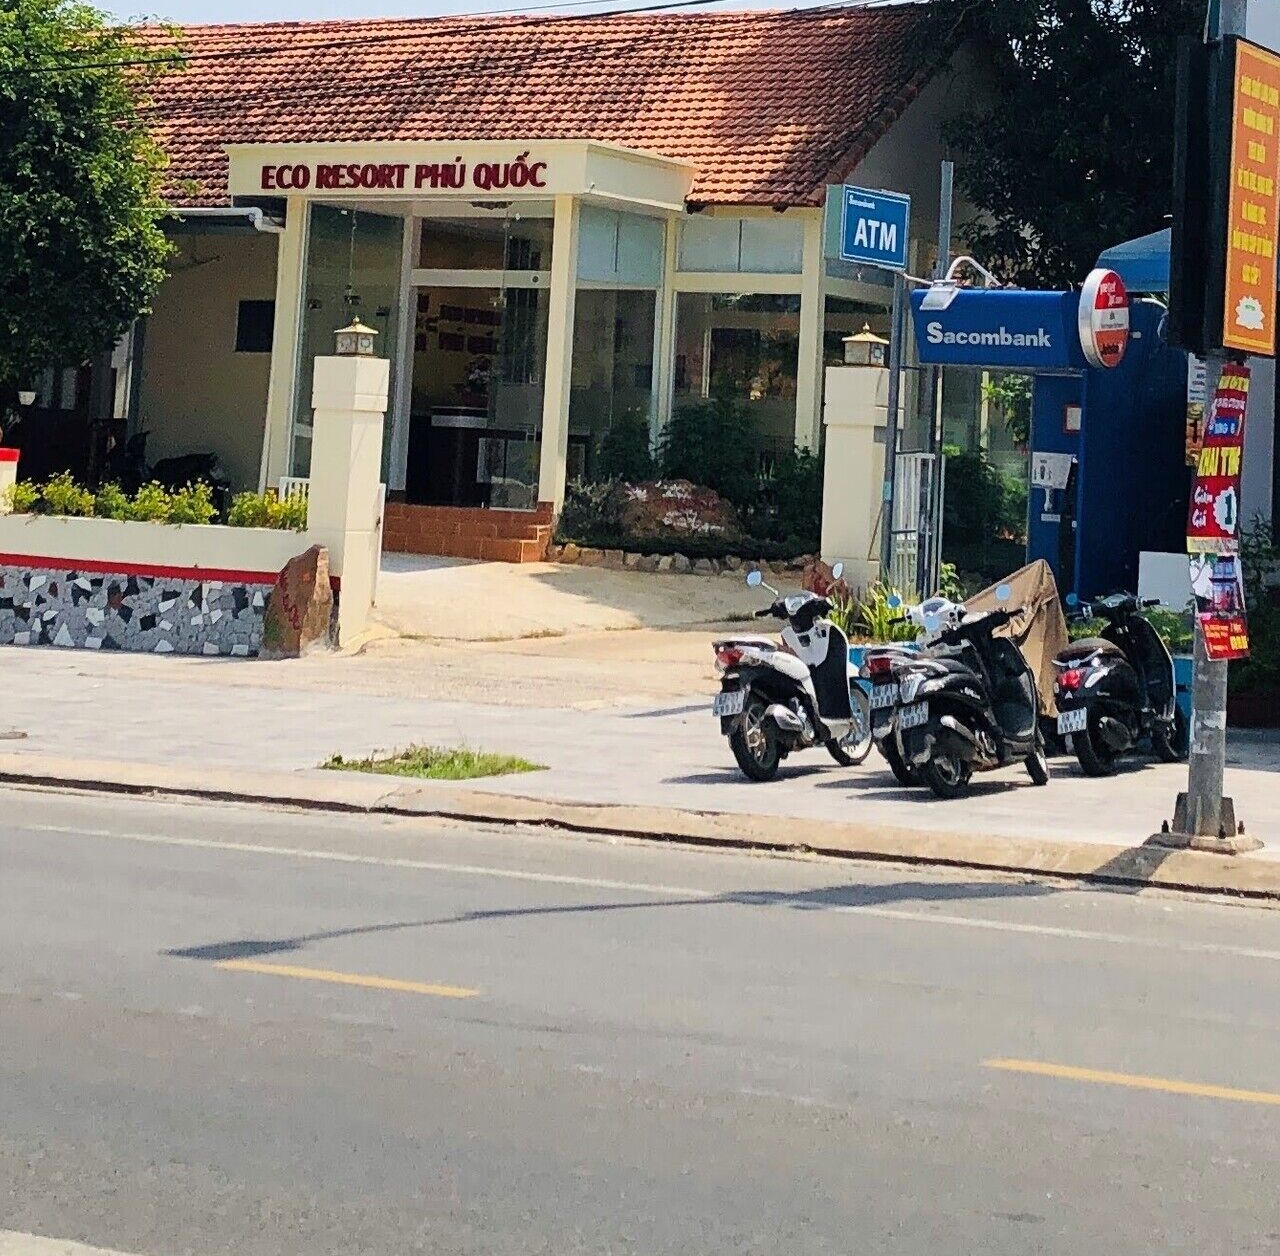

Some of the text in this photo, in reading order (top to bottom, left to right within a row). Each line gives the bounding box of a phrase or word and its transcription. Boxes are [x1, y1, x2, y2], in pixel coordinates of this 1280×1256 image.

[261, 150, 548, 190] ECO RESORT PHÚ QUỐC
[853, 217, 897, 253] ATM
[926, 321, 1052, 348] Sacombank
